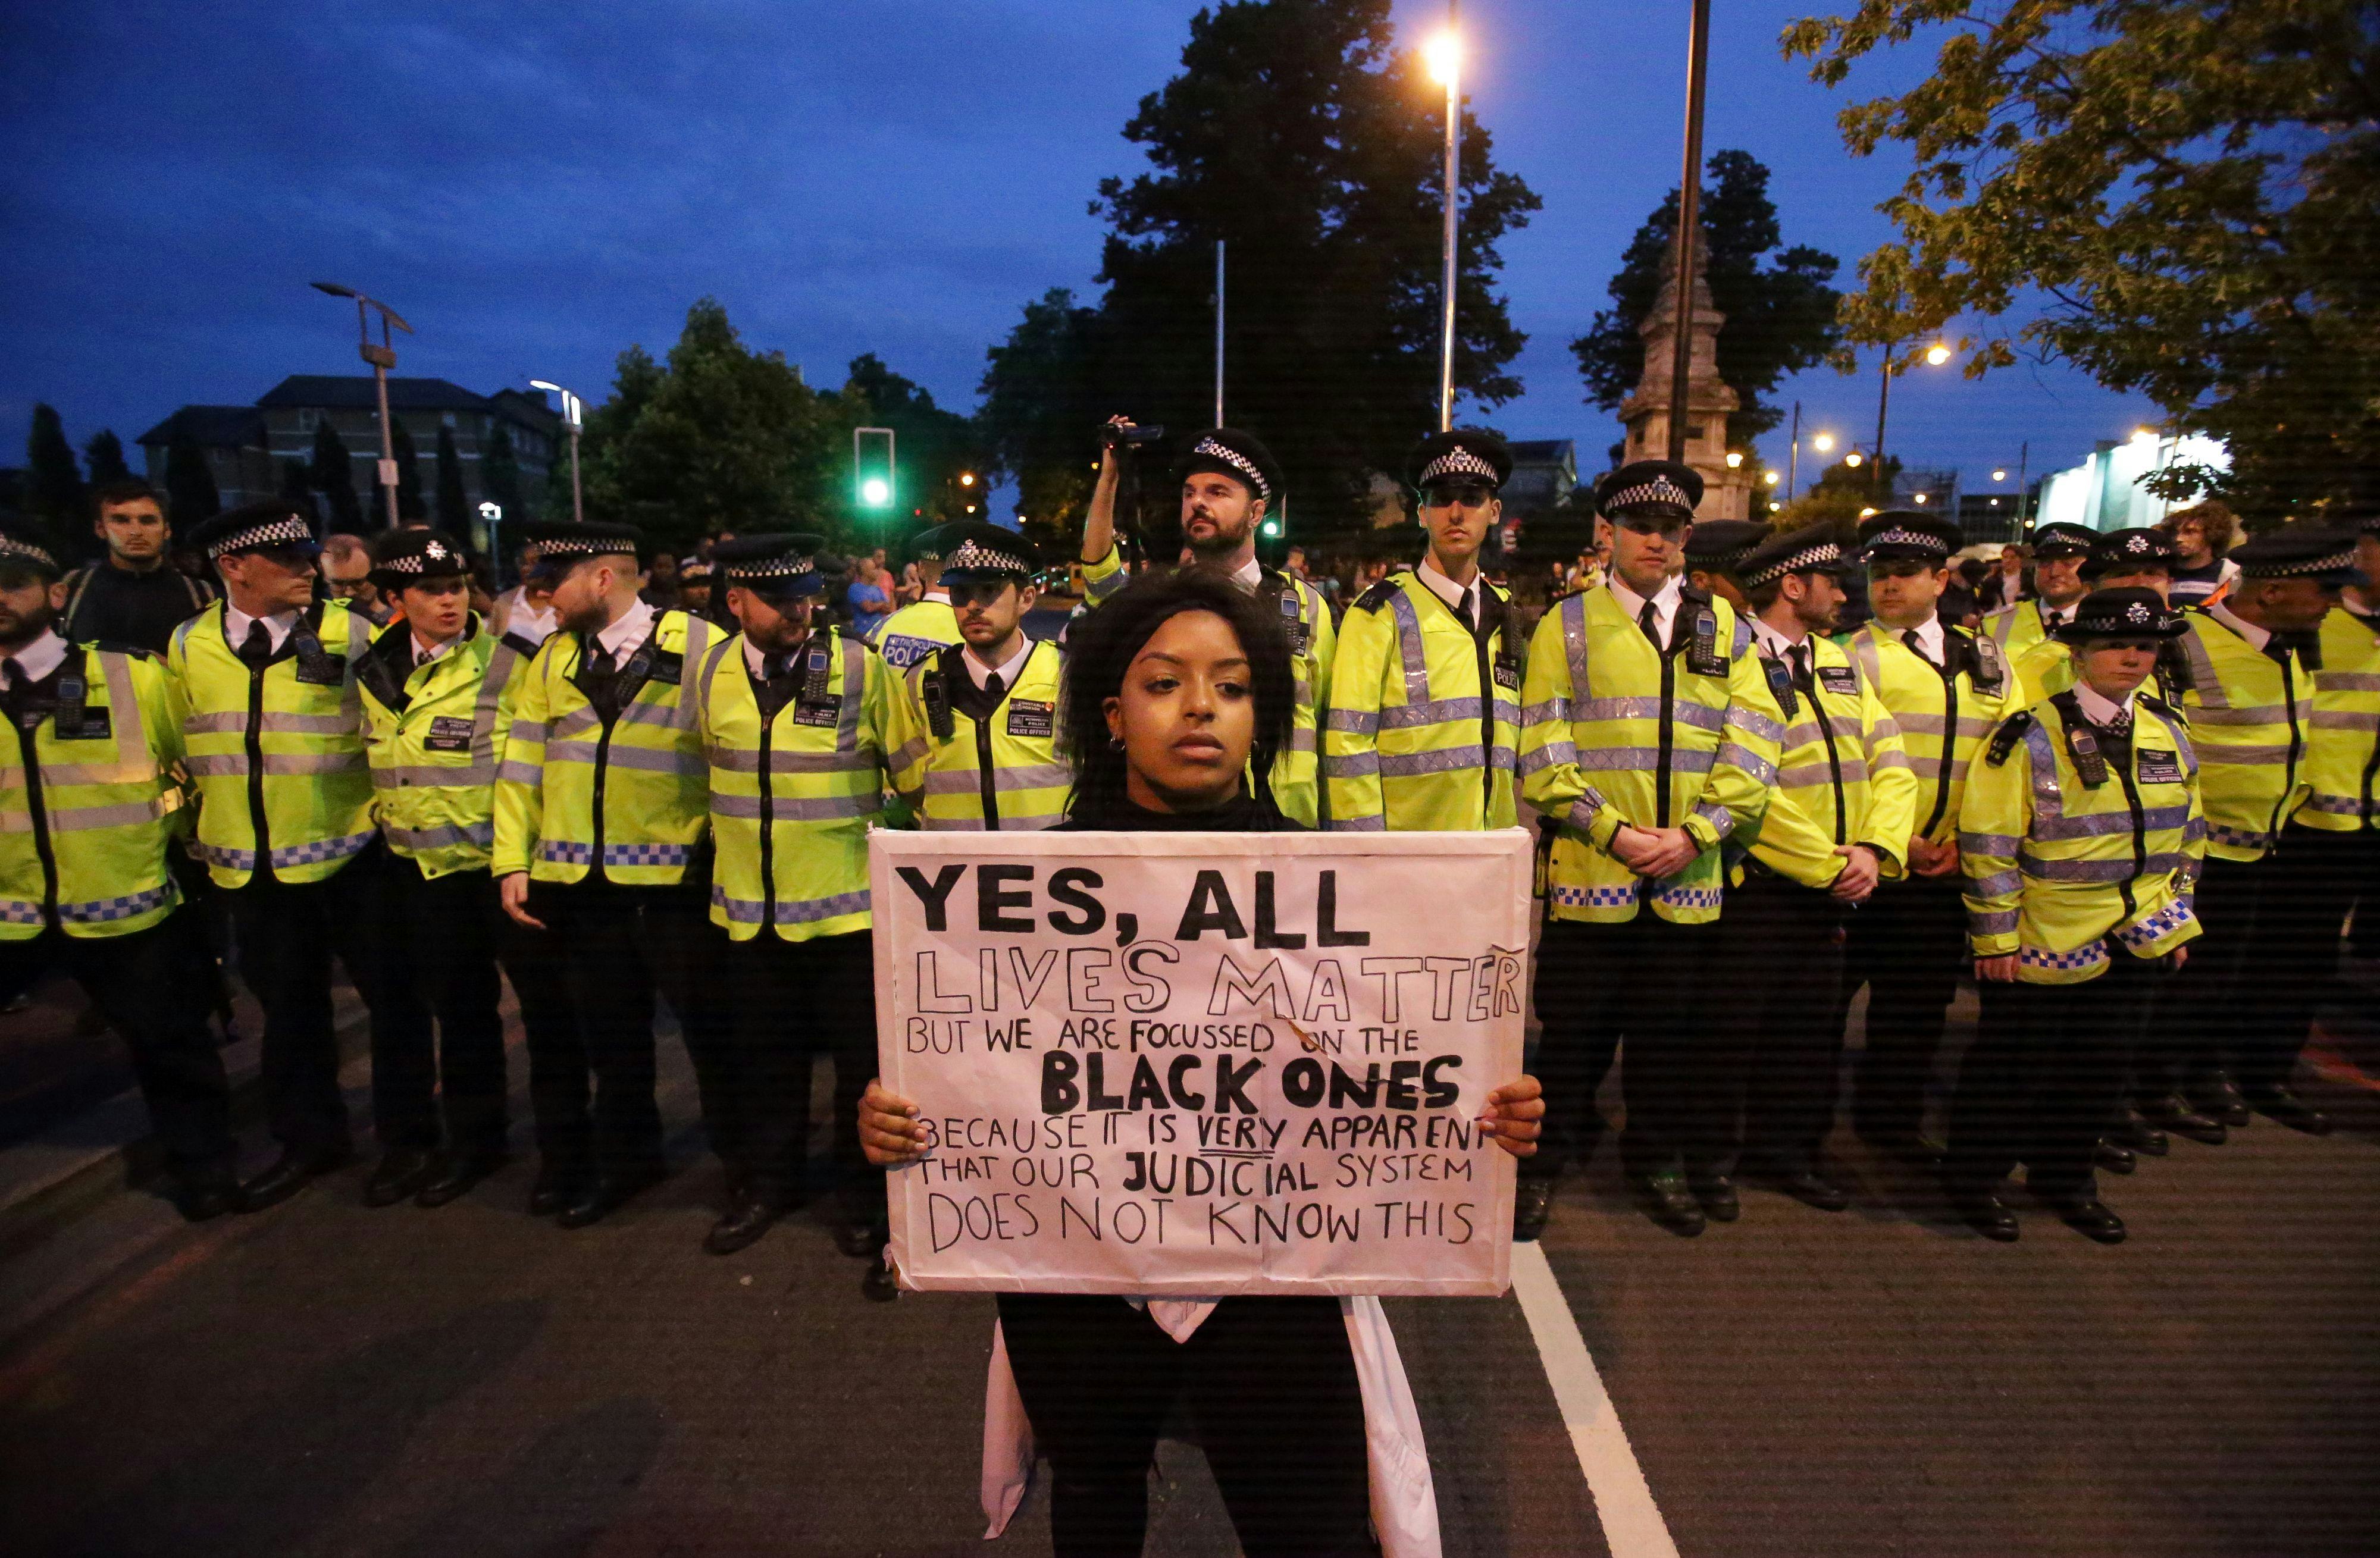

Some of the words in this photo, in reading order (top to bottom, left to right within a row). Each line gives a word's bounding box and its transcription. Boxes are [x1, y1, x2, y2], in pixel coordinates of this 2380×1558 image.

[885, 645, 926, 665] POLI
[895, 864, 1138, 947] YES,
[1174, 870, 1370, 950] ALL
[916, 939, 1180, 1014] LIVES
[1207, 954, 1520, 1023] MATTER
[907, 1017, 971, 1055] BUT
[985, 1017, 1033, 1053] WE
[1057, 1017, 1121, 1049] ARE
[1130, 1018, 1275, 1053] FOCUSSED
[1300, 1029, 1345, 1055] ON
[1358, 1027, 1420, 1055] THE
[1041, 1049, 1267, 1115] BLACK
[1281, 1054, 1464, 1111] ONES
[917, 1114, 1088, 1153] BECAUSE
[1103, 1111, 1133, 1145] IT
[1148, 1113, 1177, 1143] IS
[1197, 1114, 1288, 1150] VERY
[917, 1156, 1000, 1186] THAT
[1012, 1153, 1100, 1189] OUR
[1122, 1151, 1319, 1197] JUDICIAL
[1335, 1152, 1472, 1187] SYSTEM
[929, 1192, 1039, 1253] DOES
[1060, 1196, 1175, 1244] NOT
[1209, 1201, 1360, 1245] KNOW
[1374, 1200, 1475, 1244] THIS
